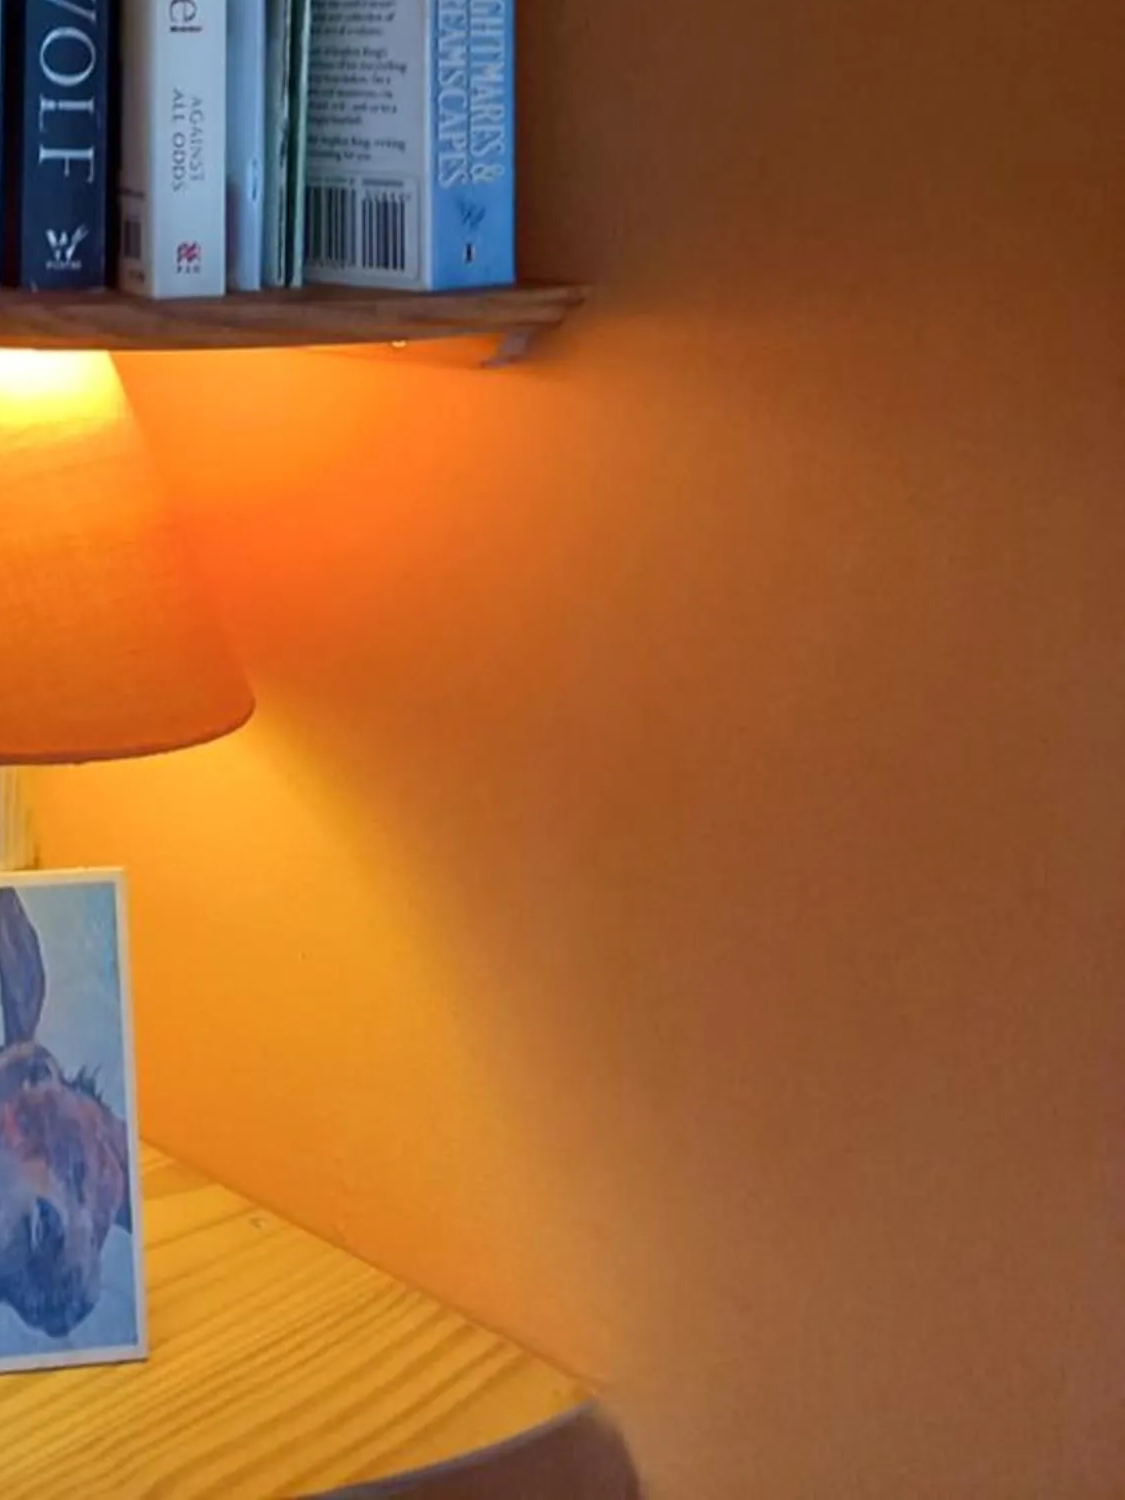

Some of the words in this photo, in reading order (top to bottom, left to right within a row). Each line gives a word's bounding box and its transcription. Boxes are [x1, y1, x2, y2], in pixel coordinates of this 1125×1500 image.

[171, 87, 186, 123] ALL
[171, 131, 187, 195] ODDS
[188, 94, 205, 182] AGAINST
[471, 161, 506, 186] &
